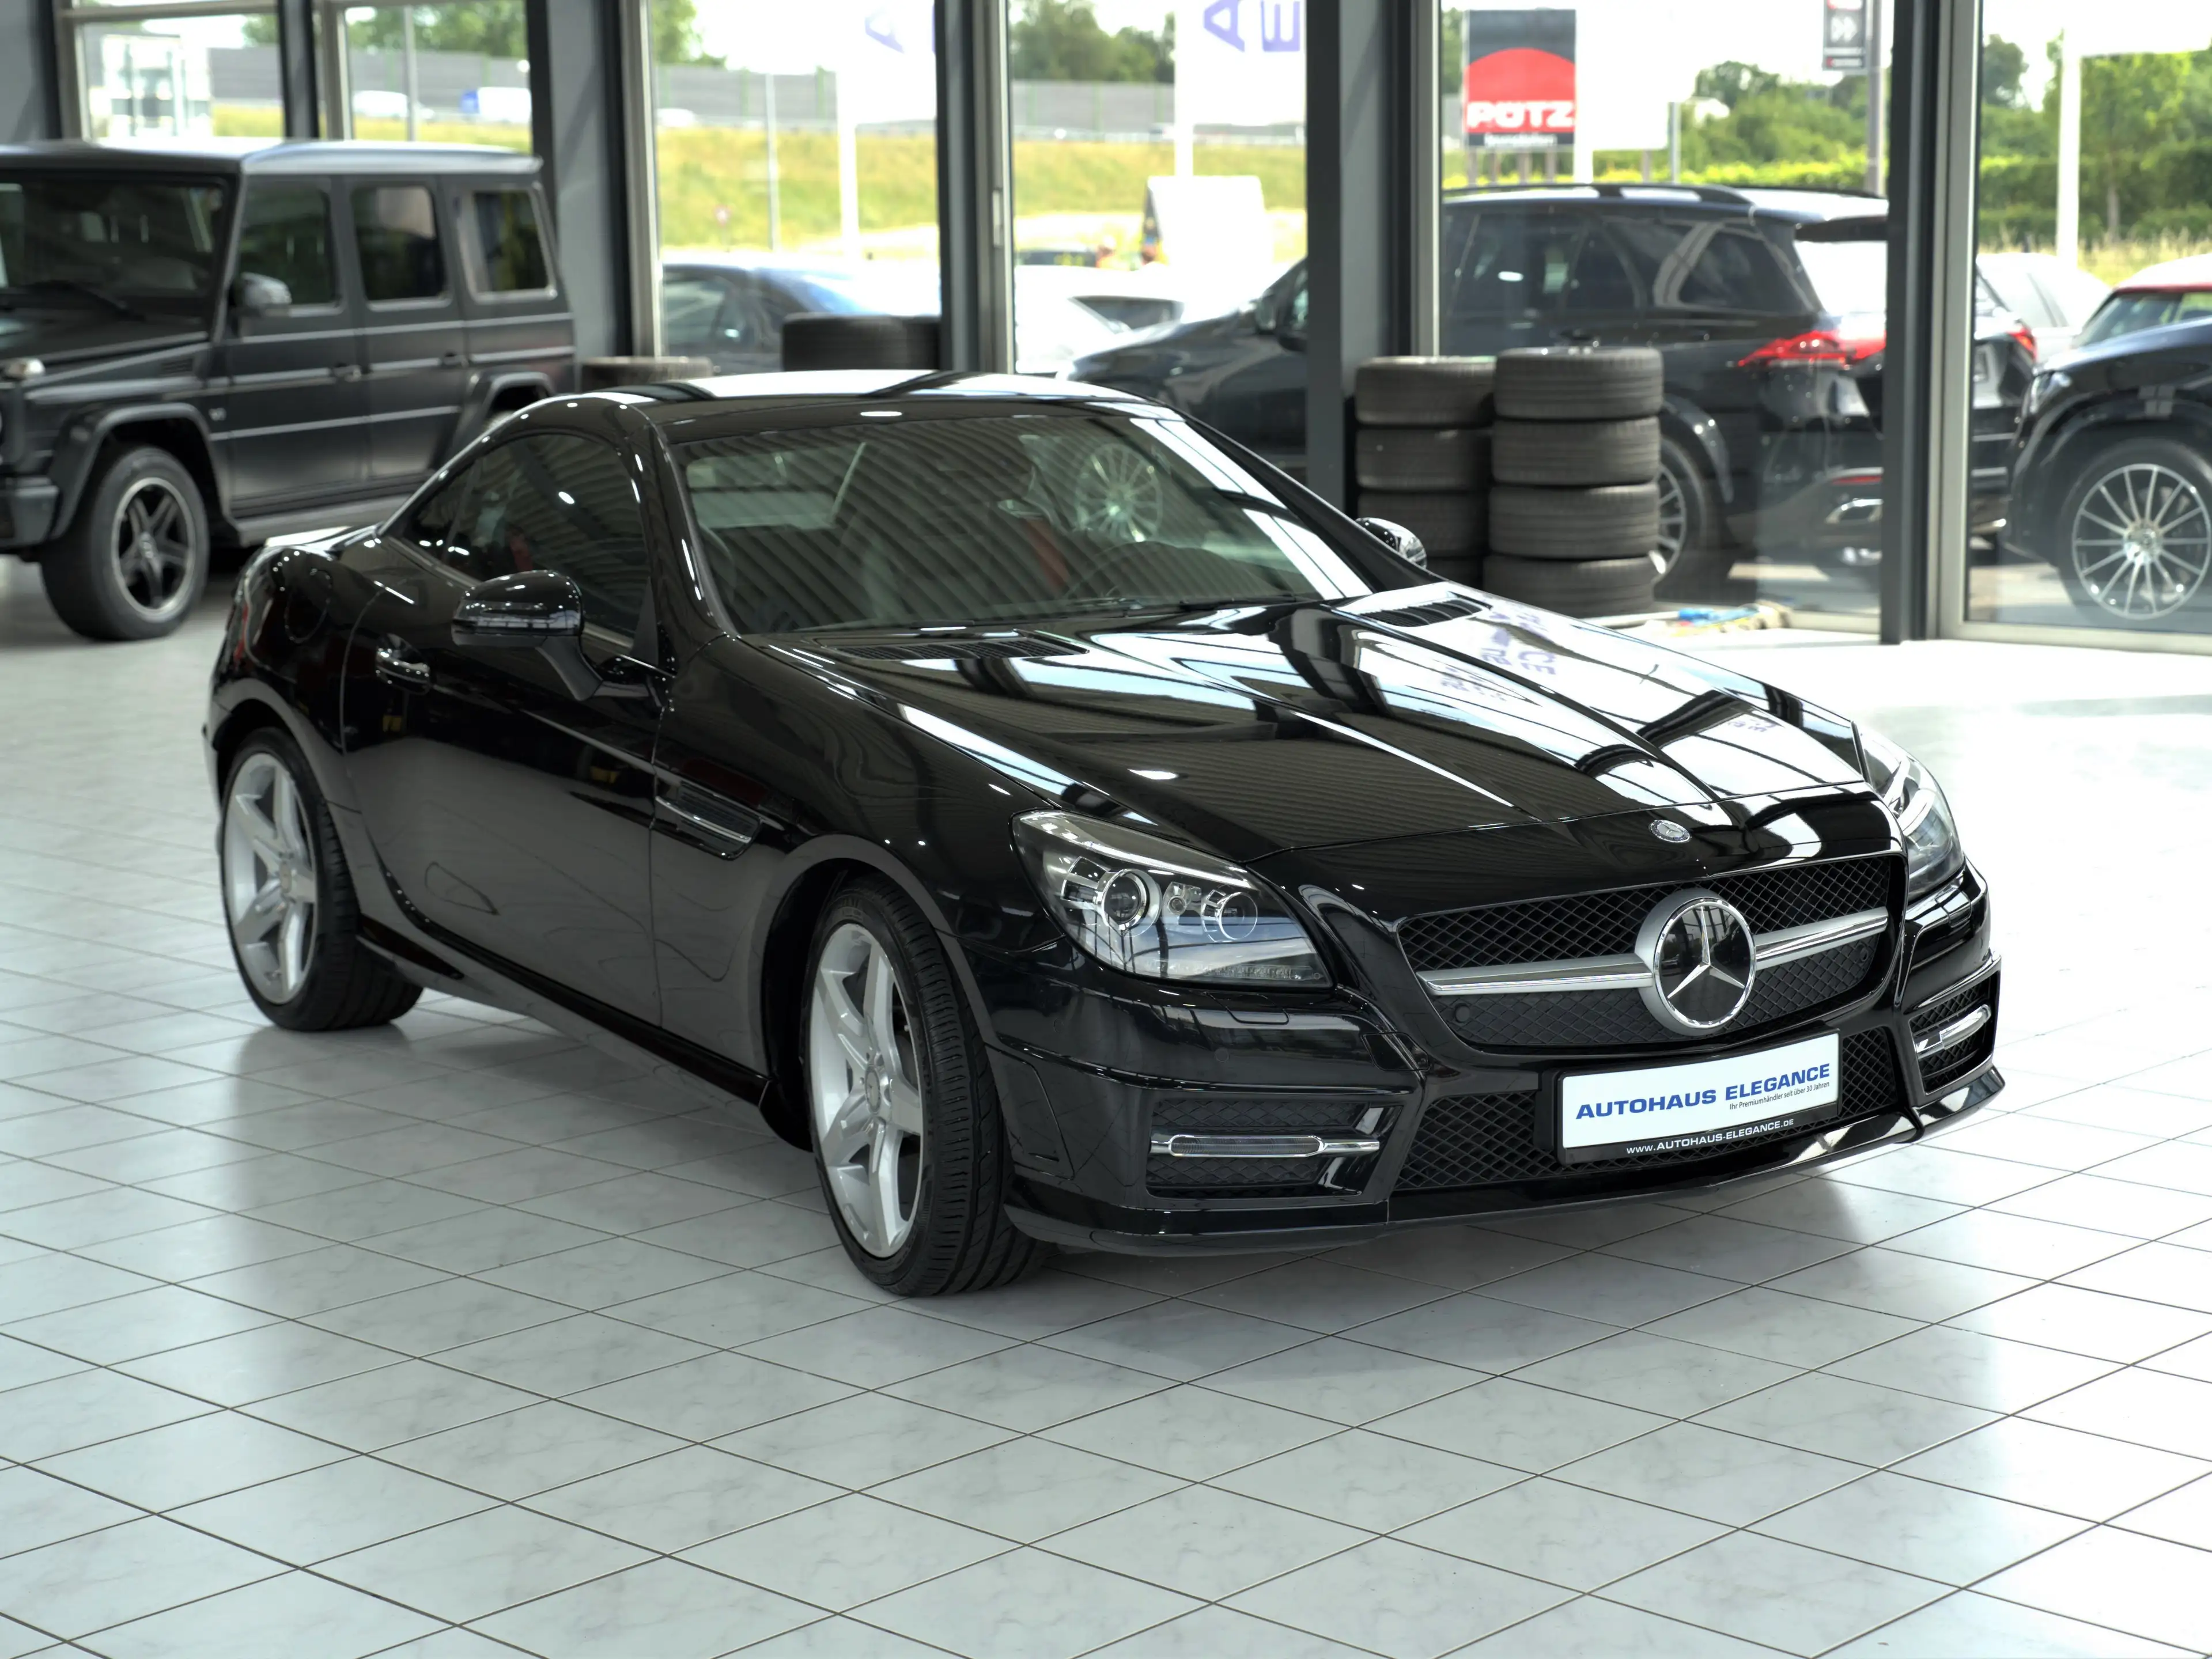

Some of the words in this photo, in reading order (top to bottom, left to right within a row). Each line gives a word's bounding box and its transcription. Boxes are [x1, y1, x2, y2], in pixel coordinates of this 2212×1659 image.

[1576, 1089, 1716, 1119] AUTOHAUS
[1726, 1063, 1829, 1100] ELEGANCE
[1739, 1093, 1783, 1108] Premiumhändler
[1794, 1088, 1805, 1096] über
[1813, 1081, 1829, 1090] Jahren
